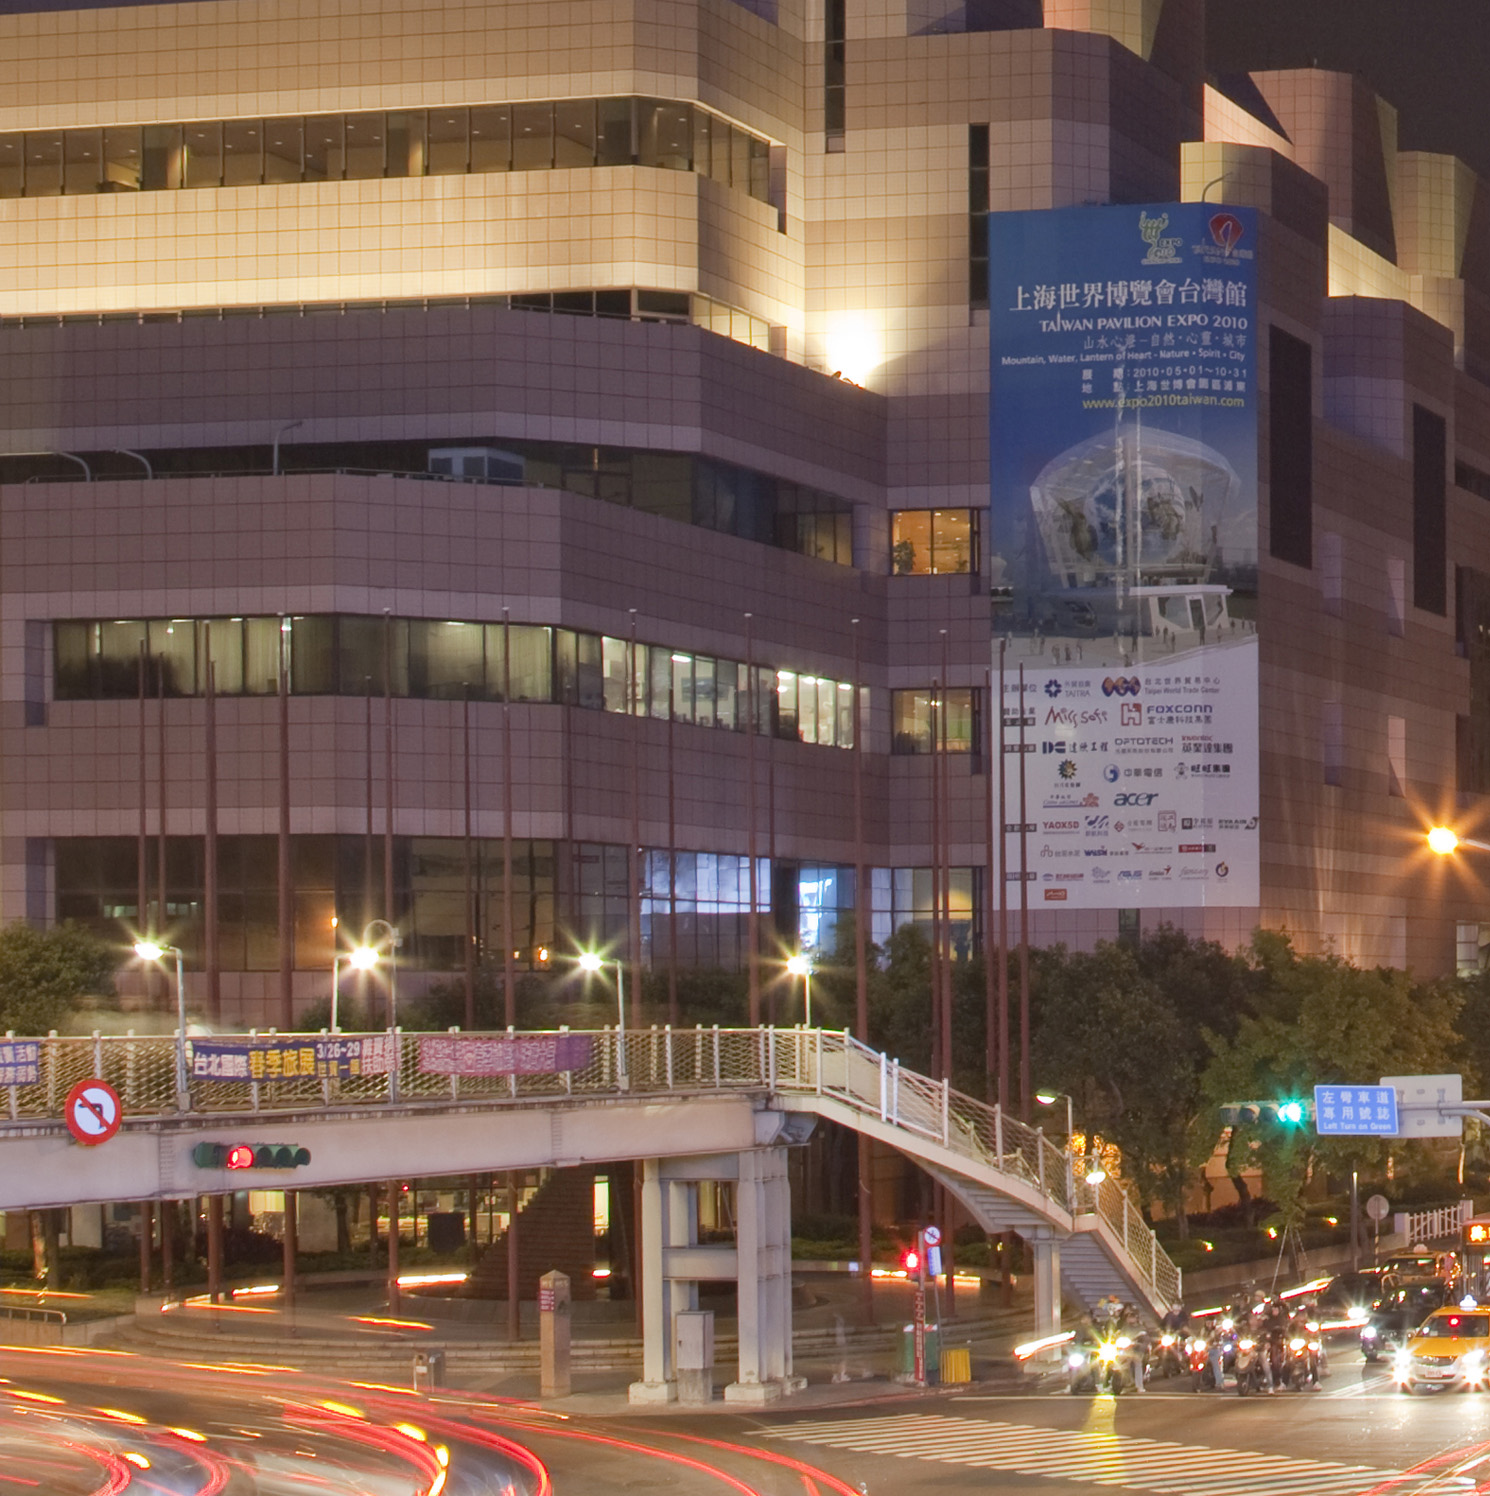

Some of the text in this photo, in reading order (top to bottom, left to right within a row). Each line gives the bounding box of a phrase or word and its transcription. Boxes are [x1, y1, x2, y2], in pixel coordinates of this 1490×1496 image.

[1009, 278, 1248, 311] 上海世界博覽會台灣館
[1039, 311, 1248, 332] TAIWAN PAVILION EXPO 2010
[1001, 348, 1246, 366] Mountain, Water, Lantern of Heart Nature Spirit City
[1082, 394, 1245, 409] www.expo2010taiwan.com
[1163, 686, 1182, 695] World
[1183, 686, 1199, 695] Trade
[1124, 767, 1163, 778] 中華電信
[1113, 792, 1159, 807] acer
[1321, 1091, 1389, 1105] 左彎車道
[1323, 1106, 1390, 1120] 專用號誌
[1323, 1122, 1338, 1130] Left
[1341, 1122, 1356, 1130] Turn
[1370, 1122, 1392, 1130] Green
